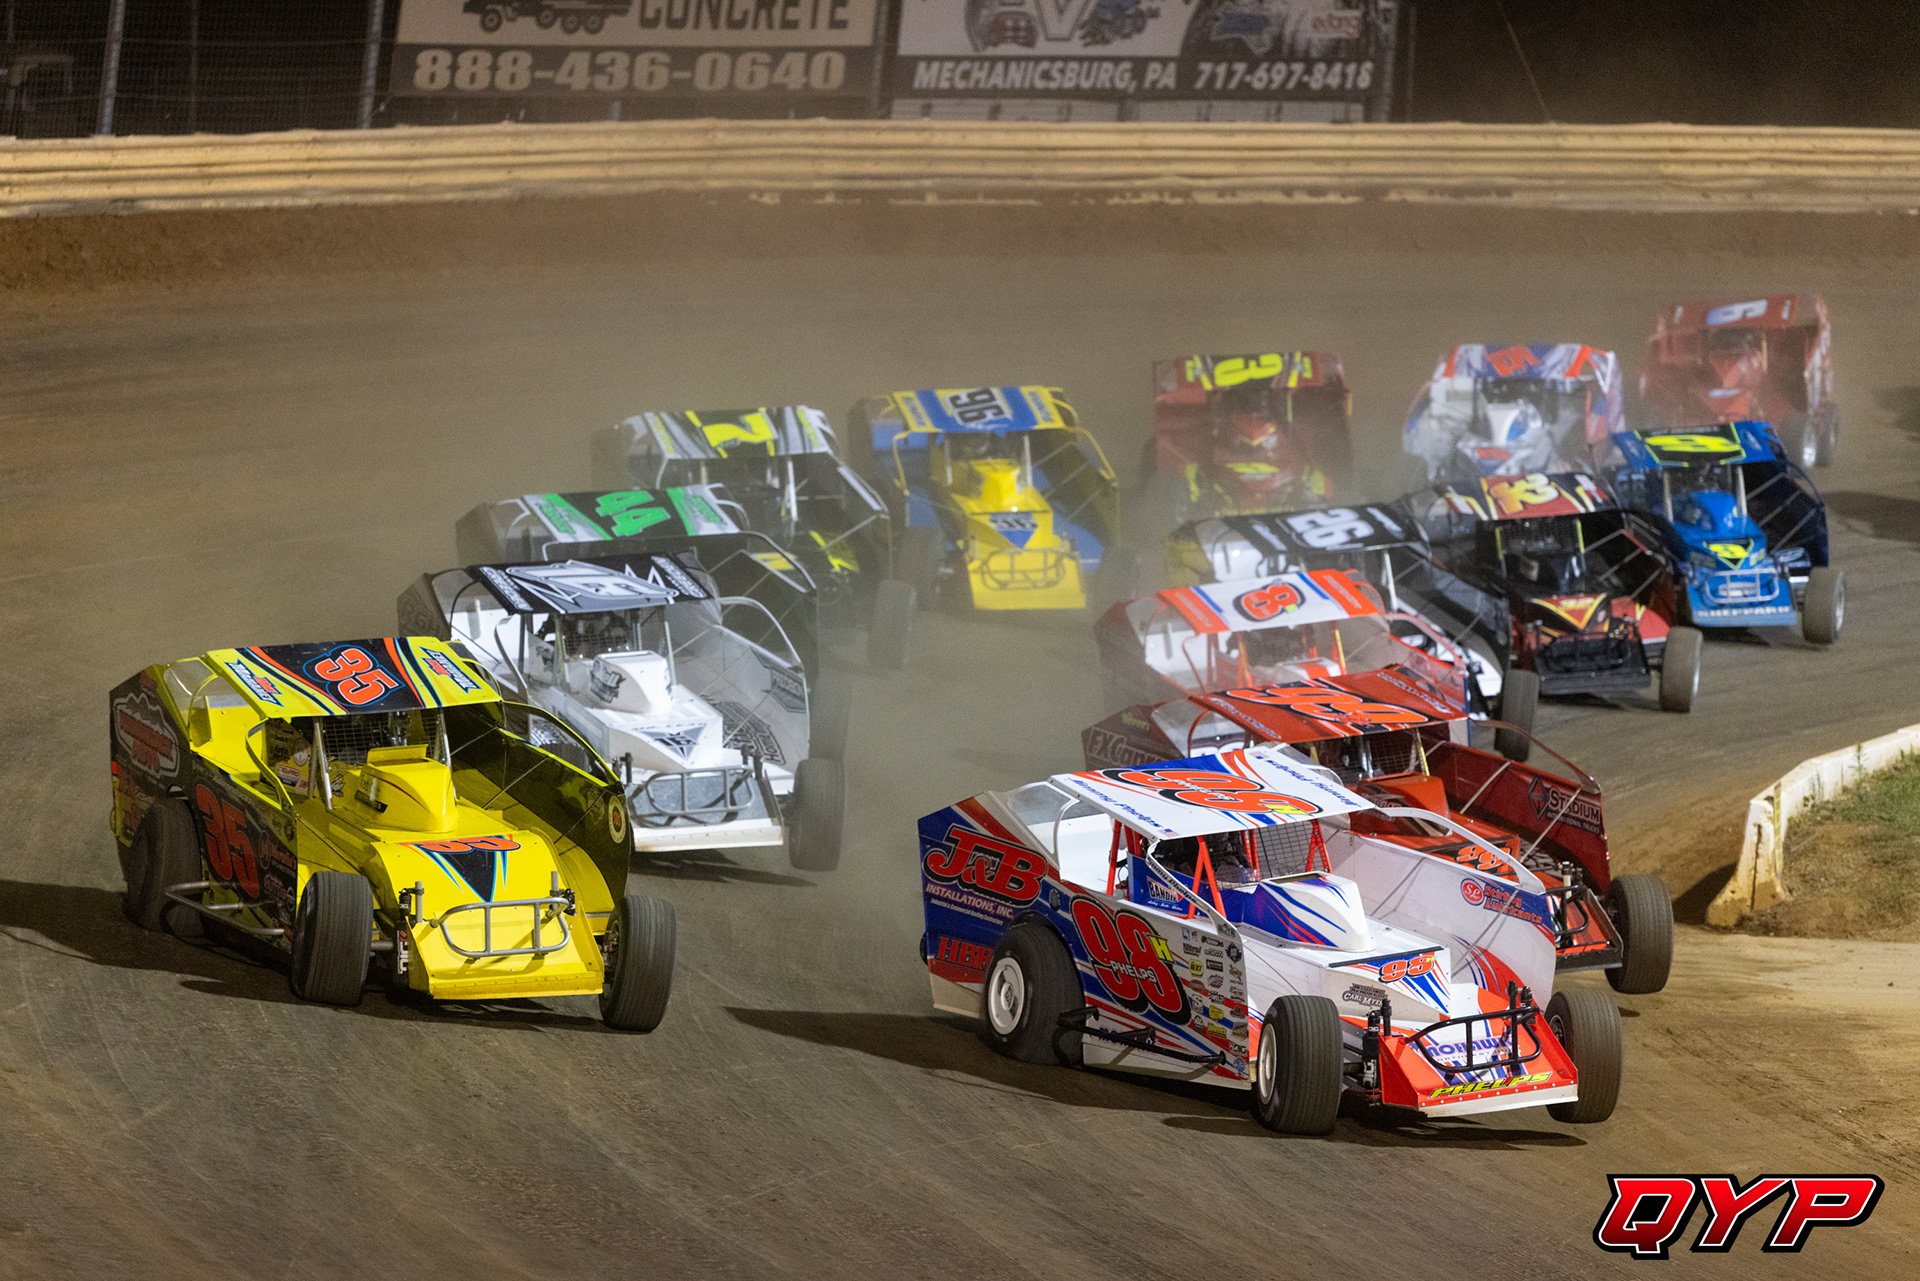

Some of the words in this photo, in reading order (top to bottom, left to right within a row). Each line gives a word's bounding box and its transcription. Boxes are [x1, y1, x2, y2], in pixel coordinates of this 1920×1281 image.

[413, 49, 846, 91] 888-436-0640
[913, 60, 1136, 93] MECHANICSBURG,
[1143, 61, 1177, 89] PA
[1194, 60, 1374, 90] 717-697-8418
[948, 388, 1004, 423] 96
[595, 490, 671, 537] 44
[313, 647, 400, 705] 35
[1549, 786, 1600, 824] STADIUM
[196, 783, 260, 899] 35
[925, 827, 1048, 903] J&B
[1110, 959, 1157, 984] PHELPS
[1428, 1071, 1552, 1099] PHELPS
